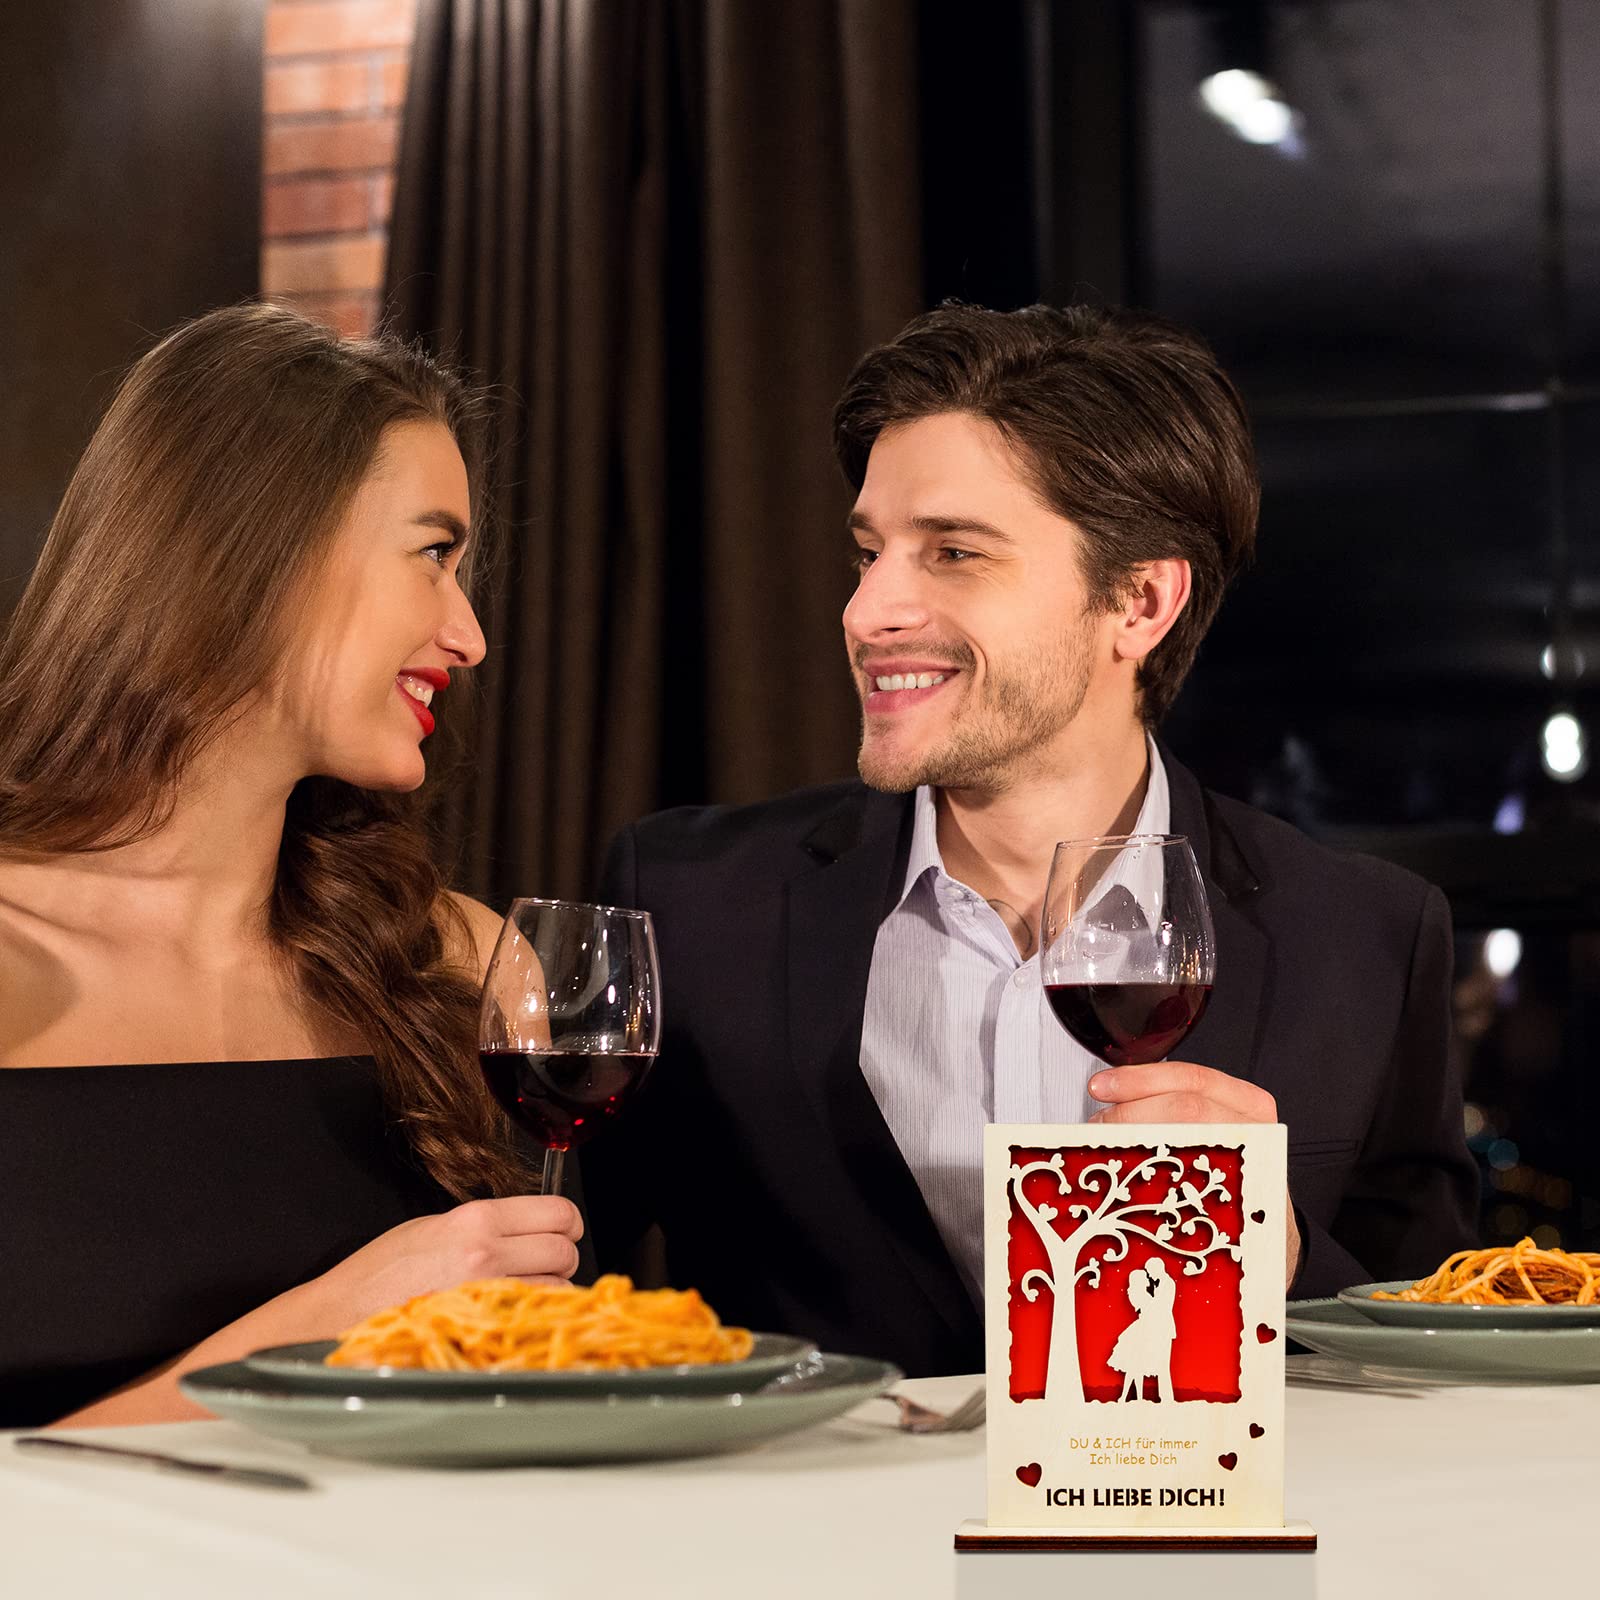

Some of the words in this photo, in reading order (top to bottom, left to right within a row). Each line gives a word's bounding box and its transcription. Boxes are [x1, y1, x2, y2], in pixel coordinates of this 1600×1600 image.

[1070, 1438, 1089, 1449] DU
[1093, 1437, 1102, 1449] &
[1105, 1438, 1131, 1449] ICH
[1135, 1438, 1156, 1449] für
[1159, 1438, 1198, 1449] immer
[1090, 1453, 1111, 1465] Ich
[1116, 1453, 1146, 1465] liebe
[1150, 1453, 1177, 1465] Dich
[1047, 1488, 1084, 1507] ICH
[1093, 1488, 1152, 1507] LIEBE
[1160, 1488, 1225, 1507] DICH!
